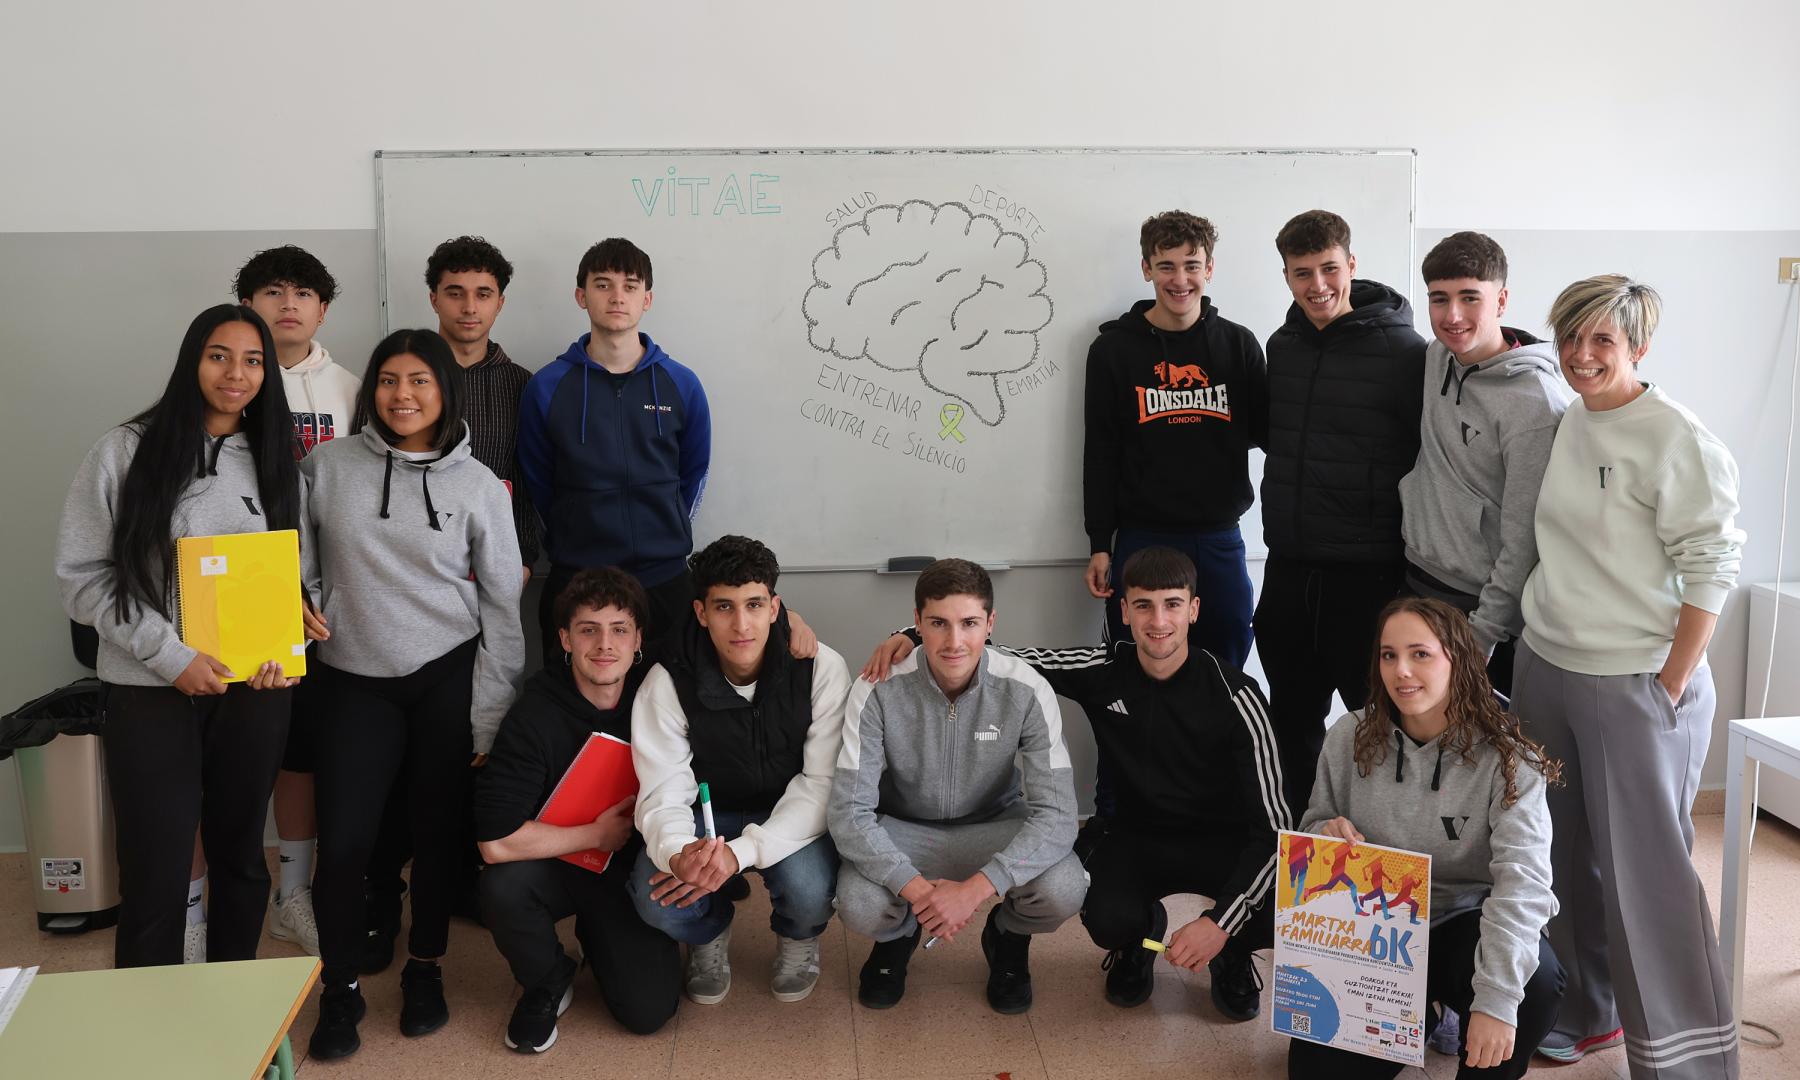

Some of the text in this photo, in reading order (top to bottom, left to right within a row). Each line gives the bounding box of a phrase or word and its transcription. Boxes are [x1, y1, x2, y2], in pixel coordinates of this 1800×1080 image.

[825, 190, 880, 228] SALUD
[969, 184, 1047, 243] DEPORTE
[817, 363, 922, 422] ENTRENAR
[1135, 383, 1231, 424] LONSDALE
[643, 404, 672, 412] MCKNZIE
[1168, 416, 1202, 424] LONDON
[800, 398, 865, 439] CONTRA
[871, 425, 890, 450] EL
[974, 731, 998, 741] PUMA
[1440, 815, 1470, 840] V
[1292, 911, 1356, 936] MARTXA
[1281, 924, 1371, 955] FAMILIARRA
[1370, 923, 1414, 967] 6K
[1344, 979, 1389, 994] GUZTIONTZAT
[1347, 988, 1364, 997] EMAN
[1366, 993, 1385, 1001] IZENA
